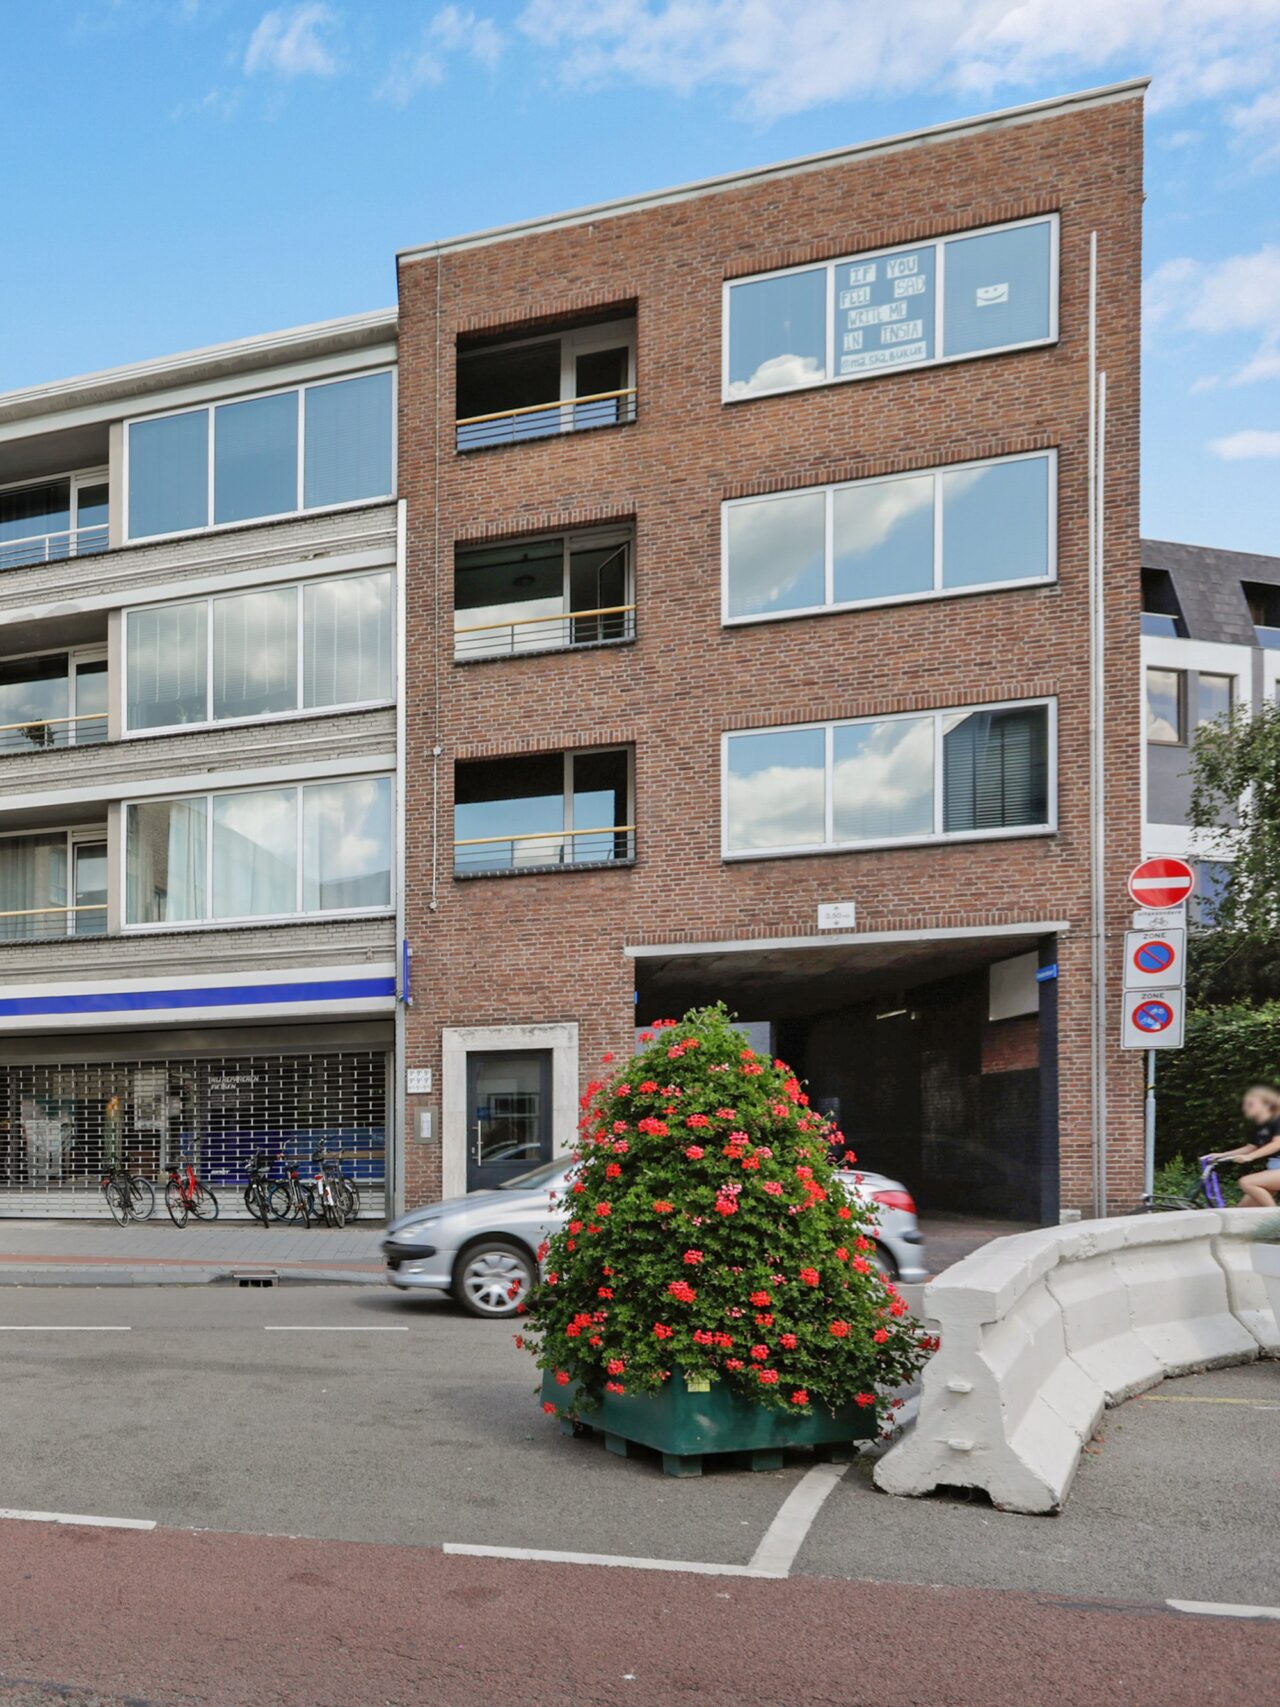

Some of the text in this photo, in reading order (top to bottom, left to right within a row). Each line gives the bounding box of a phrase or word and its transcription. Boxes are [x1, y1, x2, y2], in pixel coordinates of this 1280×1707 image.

[852, 258, 917, 284] IF YOU
[842, 277, 926, 307] FEEL SAD
[849, 301, 906, 327] WRITE ME
[846, 322, 919, 351] IN INSTA
[1143, 931, 1167, 940] ZONE
[1141, 992, 1165, 1000] ZONE
